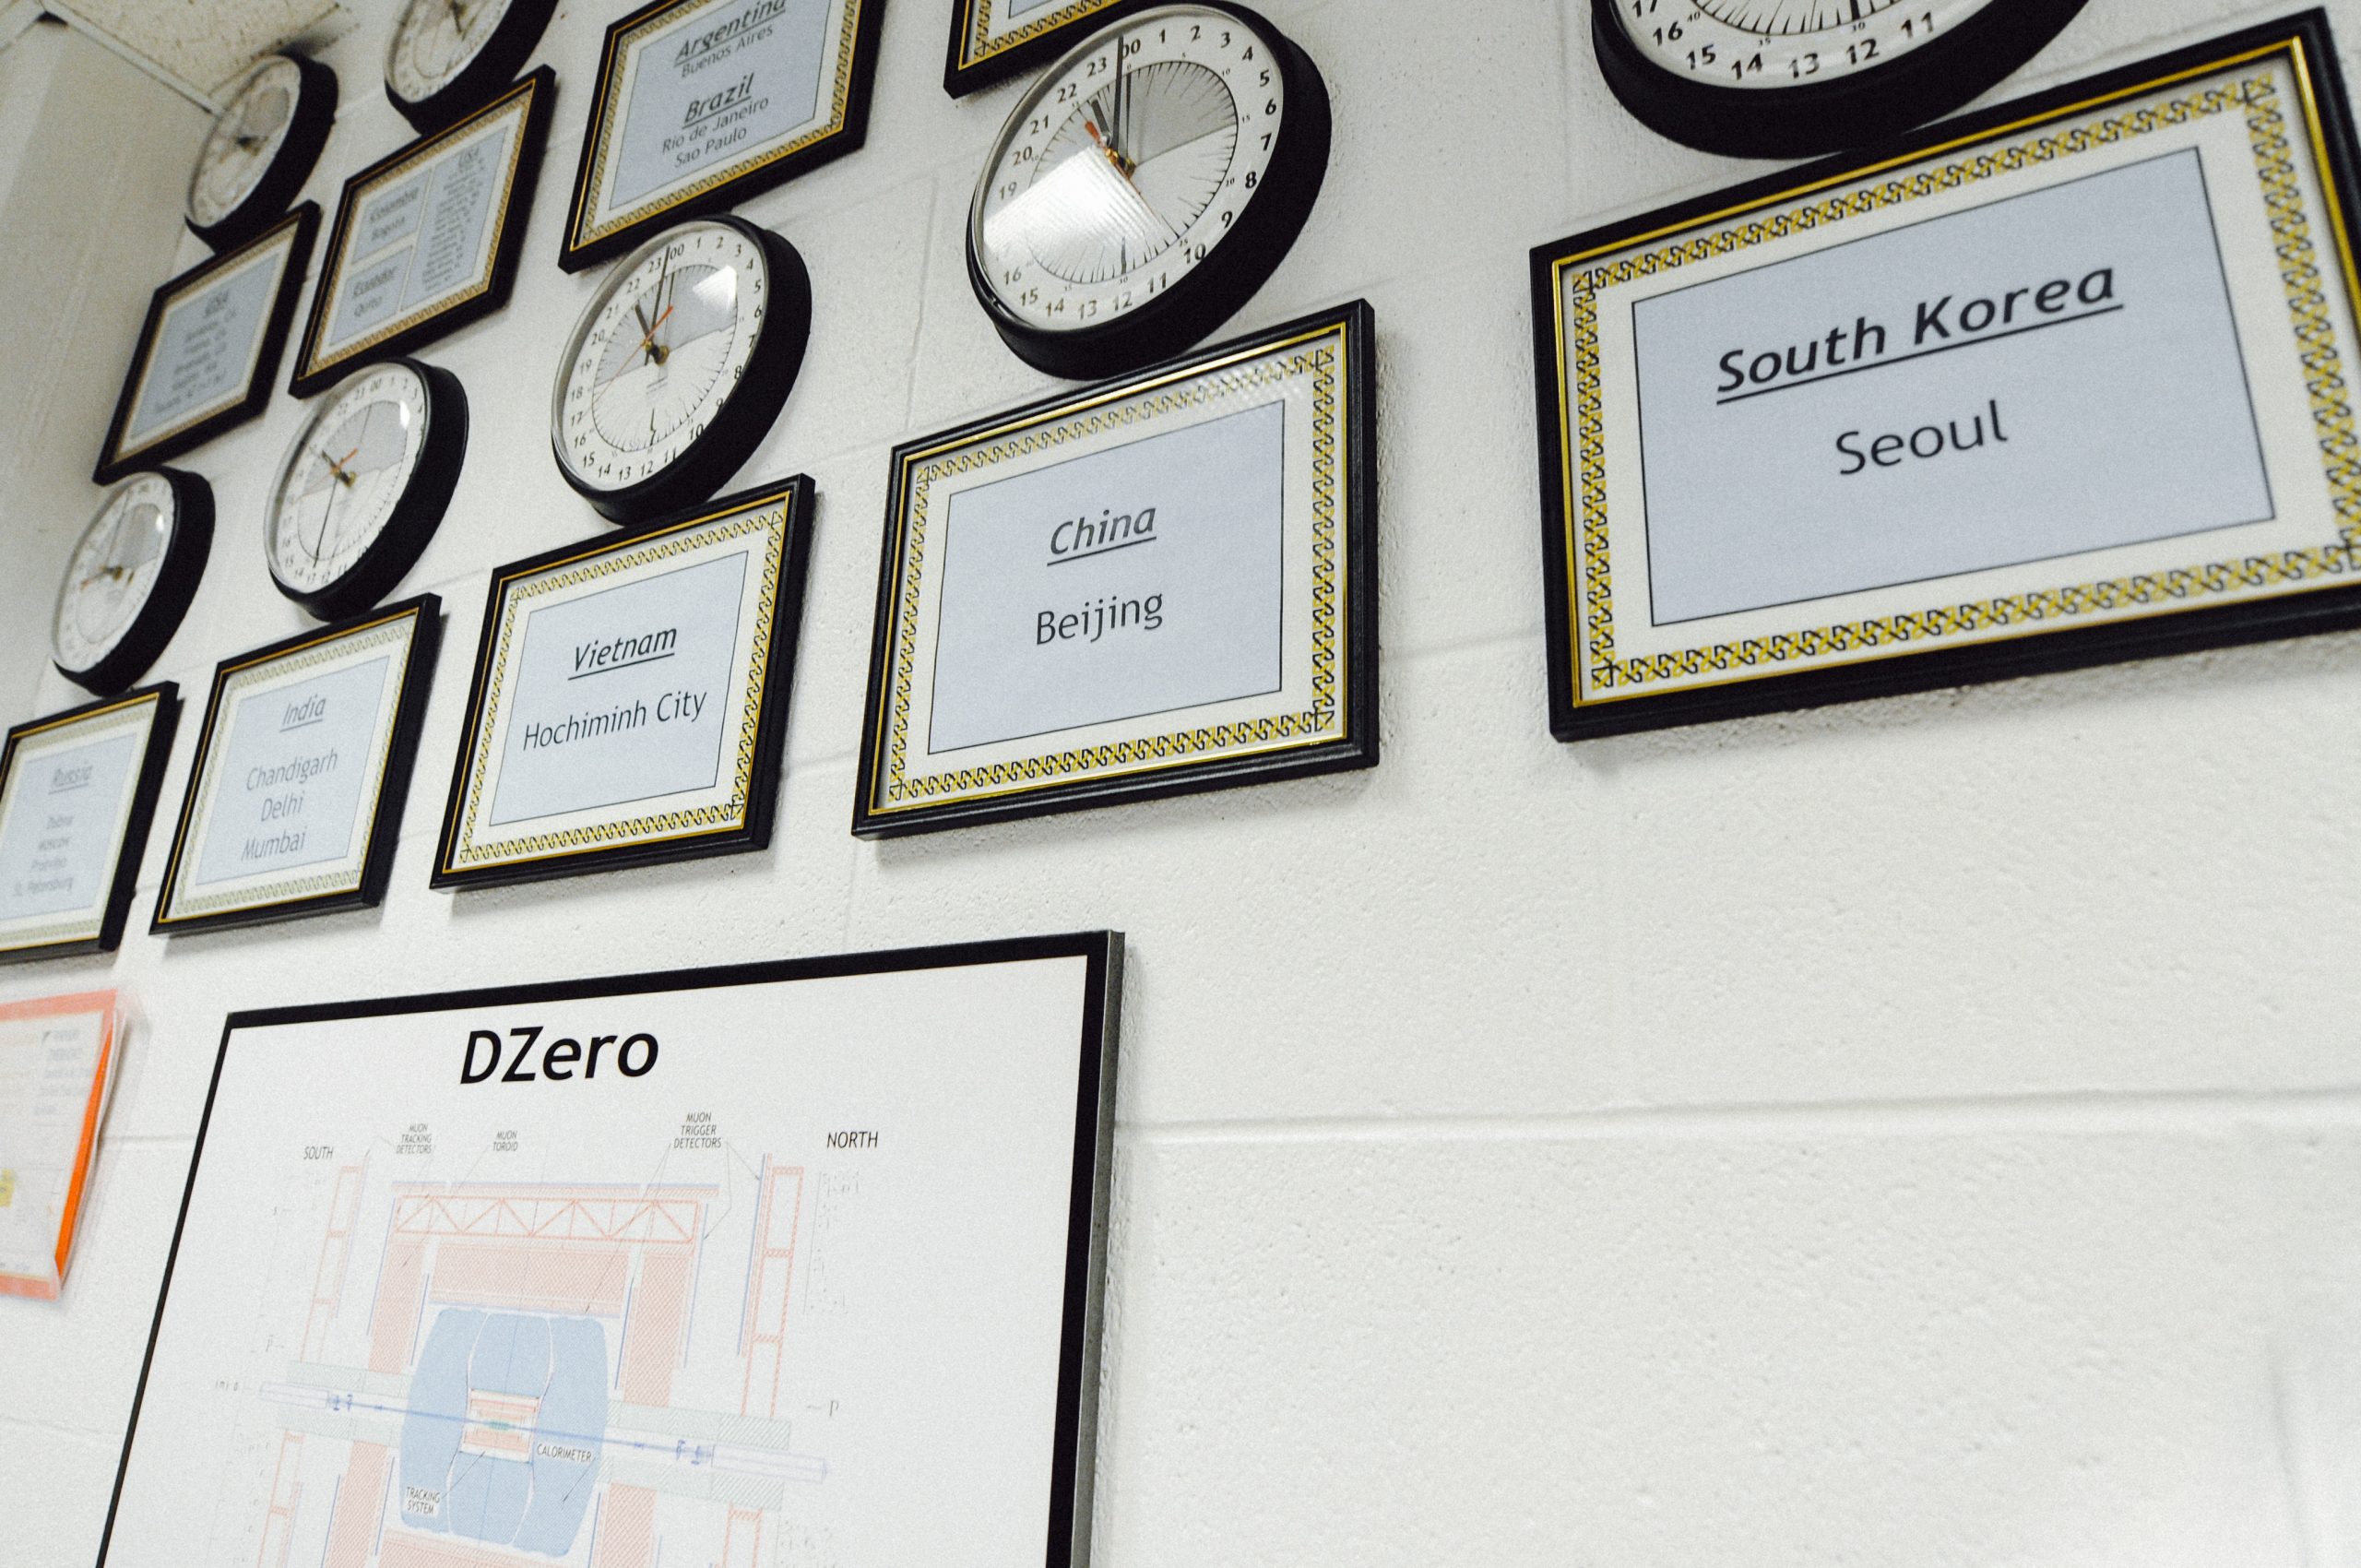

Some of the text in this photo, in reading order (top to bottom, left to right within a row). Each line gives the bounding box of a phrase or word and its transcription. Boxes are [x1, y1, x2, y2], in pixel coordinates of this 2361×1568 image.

[675, 0, 785, 59] Argentina
[1191, 25, 1201, 42] 2
[1653, 20, 1683, 46] 16
[1901, 11, 1933, 39] 11
[1159, 29, 1166, 44] 1
[1221, 32, 1230, 49] 3
[682, 25, 773, 78] Buenos Aires
[1242, 46, 1253, 62] 4
[1686, 43, 1716, 71] 15
[1846, 38, 1880, 65] 12
[1086, 56, 1107, 77] 23
[1731, 53, 1763, 80] 14
[1788, 52, 1820, 79] 13
[1260, 69, 1270, 88] 5
[684, 72, 754, 124] Brazil
[1057, 82, 1078, 103] 22
[1265, 98, 1276, 115] 6
[662, 98, 768, 153] Rio de Janeiro
[1029, 114, 1049, 136] 21
[675, 127, 747, 168] Sao Paulo
[1261, 133, 1272, 151] 7
[1013, 146, 1032, 166] 20
[1245, 171, 1257, 189] 8
[999, 182, 1017, 200] 19
[1221, 210, 1233, 229] 9
[697, 237, 701, 249] 1
[717, 236, 723, 249] 2
[735, 244, 742, 257] 3
[670, 244, 684, 260] 00
[1183, 244, 1206, 264] 10
[648, 257, 661, 273] 23
[746, 258, 753, 270] 4
[1003, 266, 1022, 285] 16
[1147, 272, 1167, 293] 11
[754, 279, 761, 293] 5
[1020, 287, 1038, 306] 15
[1112, 291, 1133, 311] 12
[754, 305, 762, 317] 6
[1046, 297, 1064, 317] 14
[1078, 300, 1097, 320] 13
[591, 329, 605, 346] 20
[1717, 267, 2114, 392] South Korea
[749, 334, 755, 348] 7
[734, 365, 742, 379] 8
[572, 410, 583, 426] 17
[575, 433, 586, 449] 16
[690, 423, 704, 441] 10
[1835, 399, 2009, 476] Seoul
[583, 451, 595, 469] 15
[641, 460, 653, 477] 12
[599, 462, 611, 478] 14
[619, 466, 631, 482] 13
[1050, 507, 1157, 555] China
[1037, 593, 1163, 646] Beijing
[575, 628, 677, 671] Vietnam
[282, 694, 326, 726] India
[523, 691, 707, 751] Hochiminh City
[246, 748, 338, 791] Chandigarh
[261, 790, 305, 822] Delhi
[241, 826, 308, 861] Mumbai
[460, 1026, 658, 1085] DZero
[686, 1111, 712, 1123] MUON
[409, 1123, 428, 1133] MUON
[496, 1130, 517, 1140] MUON
[681, 1124, 717, 1136] TRIGGER
[401, 1134, 433, 1144] TRACKING
[492, 1141, 518, 1152] TOROID
[673, 1137, 722, 1149] DETECTORS
[826, 1131, 879, 1149] NORTH
[303, 1146, 334, 1160] SOUTH
[396, 1145, 433, 1155] DETECTORS
[537, 1443, 593, 1463] CALORIMETER
[406, 1486, 441, 1503] TRACKING
[407, 1500, 434, 1515] SYSTEM
